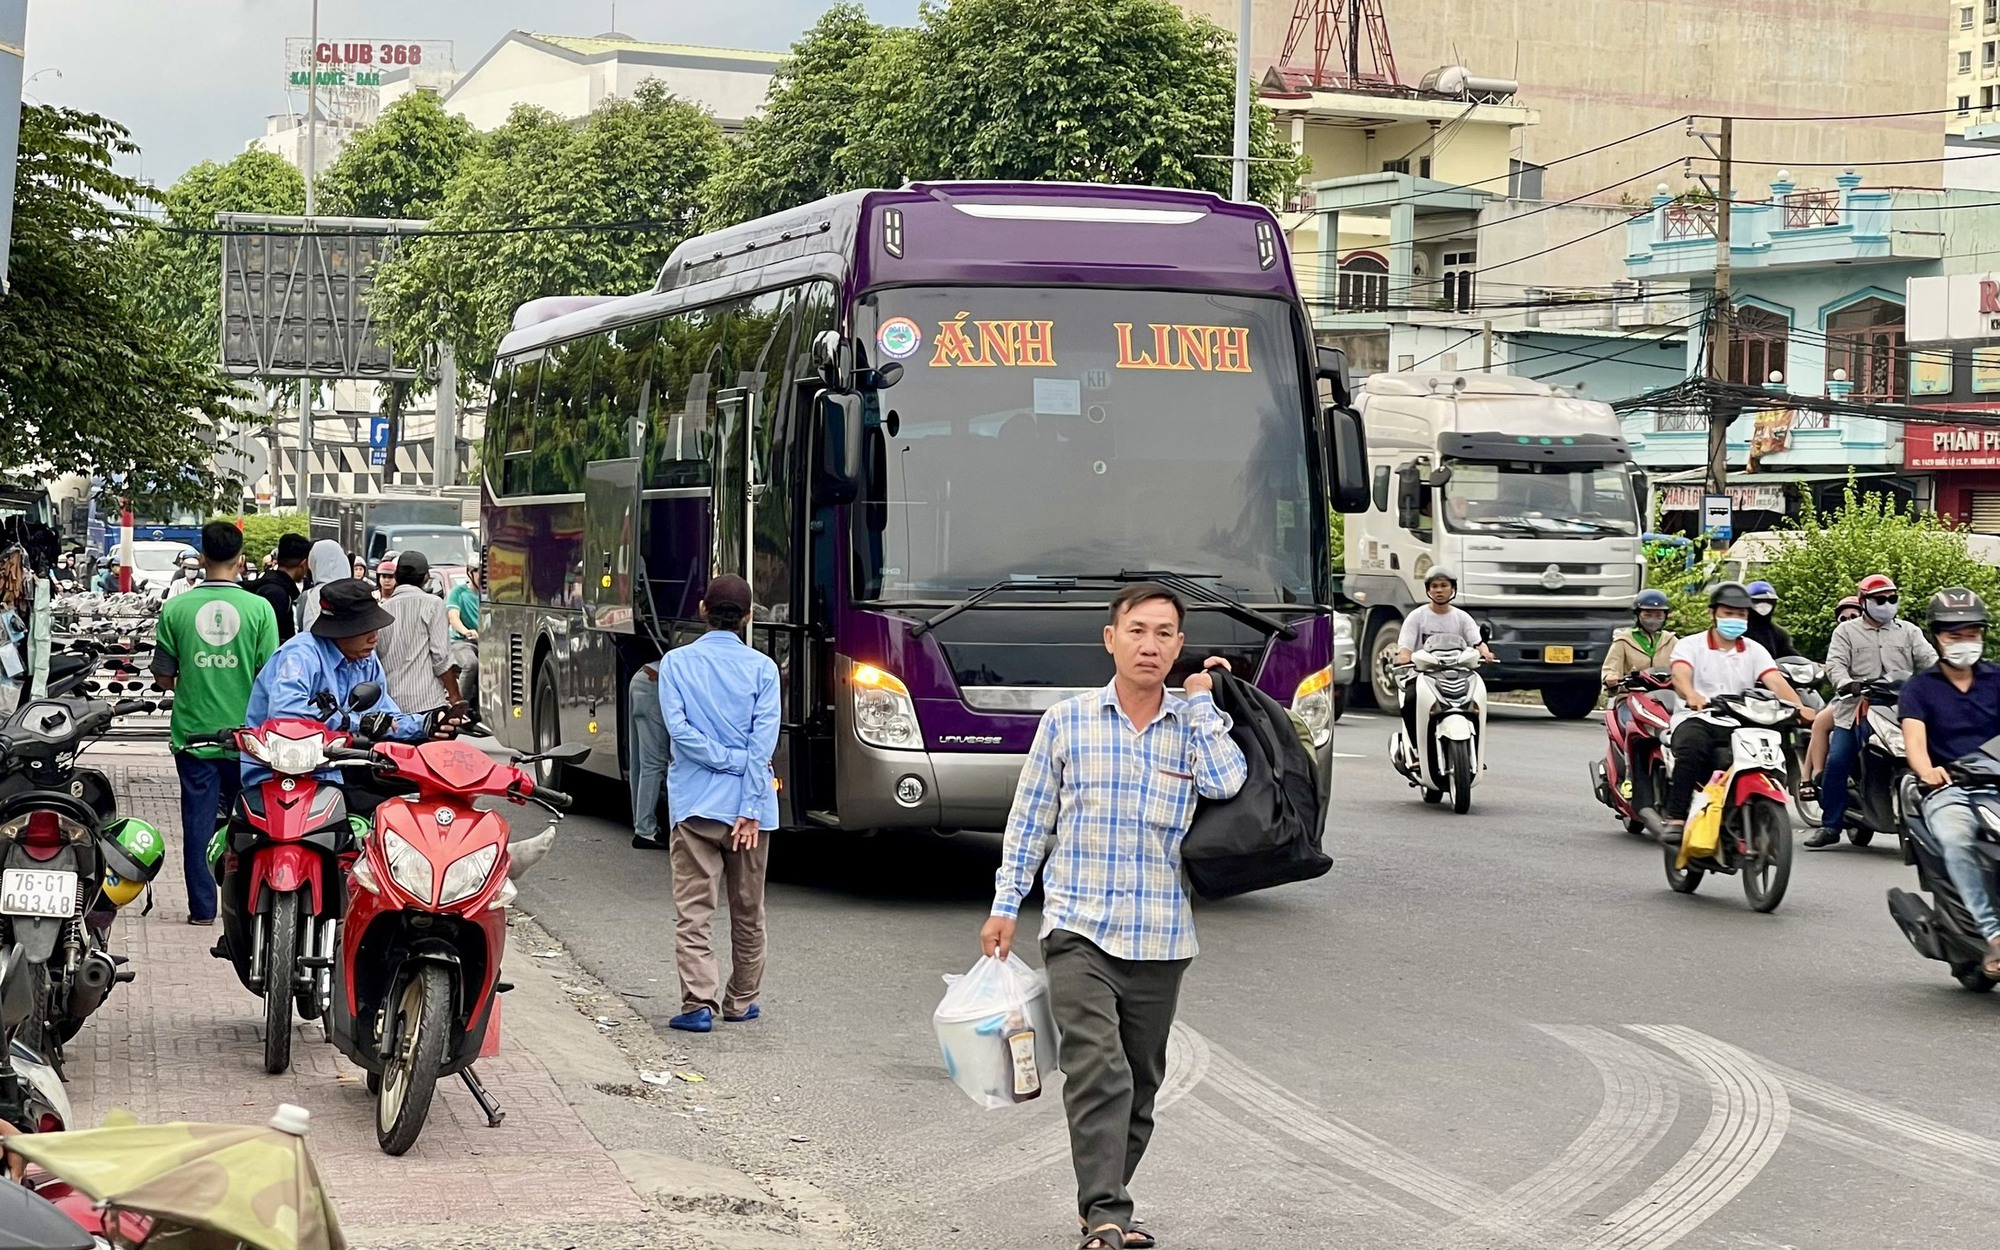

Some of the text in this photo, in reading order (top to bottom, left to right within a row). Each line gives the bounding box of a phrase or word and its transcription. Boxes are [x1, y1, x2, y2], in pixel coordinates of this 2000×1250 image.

[316, 43, 422, 65] CLUB 368
[356, 72, 380, 86] BAR
[929, 311, 1252, 372] ÁNH LINH
[1087, 370, 1106, 387] KH
[1933, 427, 1980, 452] PHÂN
[194, 649, 239, 669] Grab
[15, 873, 64, 893] 76-G1
[6, 893, 70, 914] 093.48
